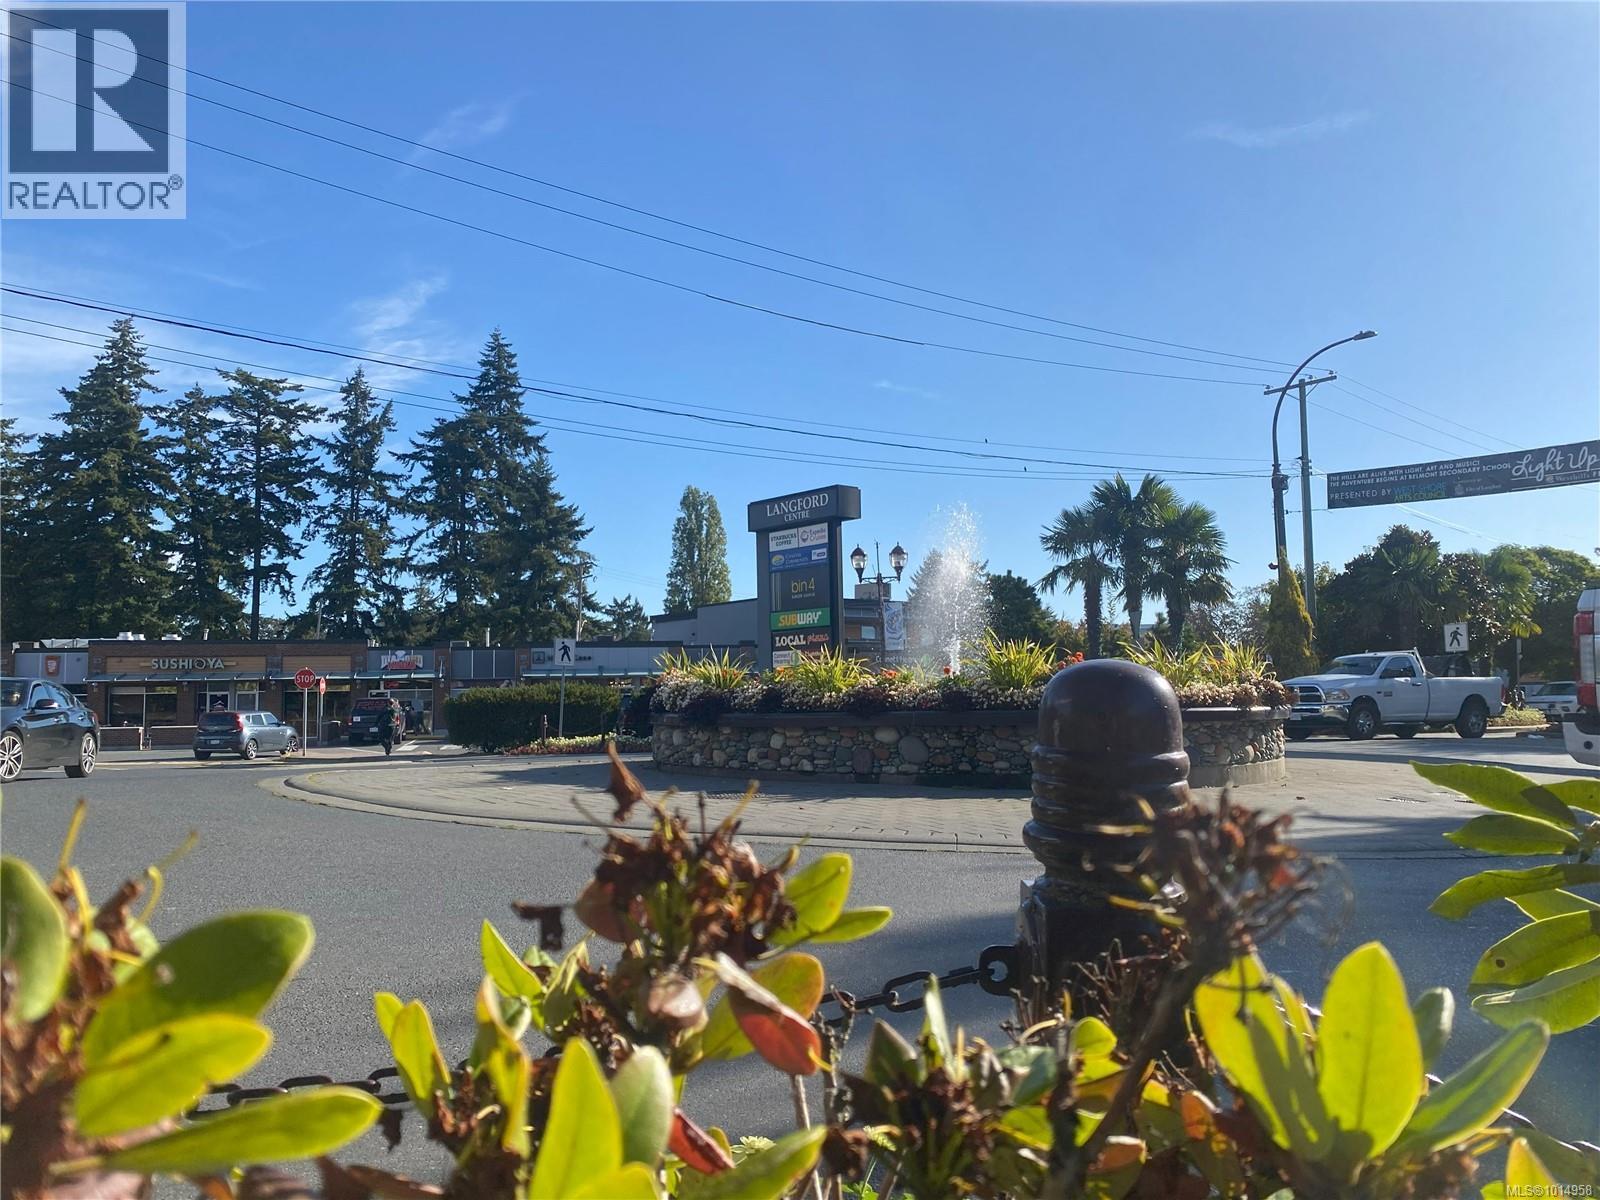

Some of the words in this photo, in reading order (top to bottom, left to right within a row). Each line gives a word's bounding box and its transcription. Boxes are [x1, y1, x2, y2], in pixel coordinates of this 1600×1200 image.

[1512, 448, 1565, 482] Light
[1567, 446, 1598, 472] Up
[1341, 478, 1374, 487] ADVENTURE
[1408, 472, 1438, 480] BELMONT
[1439, 467, 1480, 477] SECONDARY
[1482, 462, 1511, 472] SCHOOL
[1330, 489, 1378, 500] PRESENTED
[1381, 488, 1392, 496] BY
[766, 493, 829, 516] LANGFORD
[784, 510, 810, 522] CENTRE
[778, 611, 822, 627] SUBWAY
[775, 634, 806, 647] LOCAL
[296, 674, 314, 683] STOP
